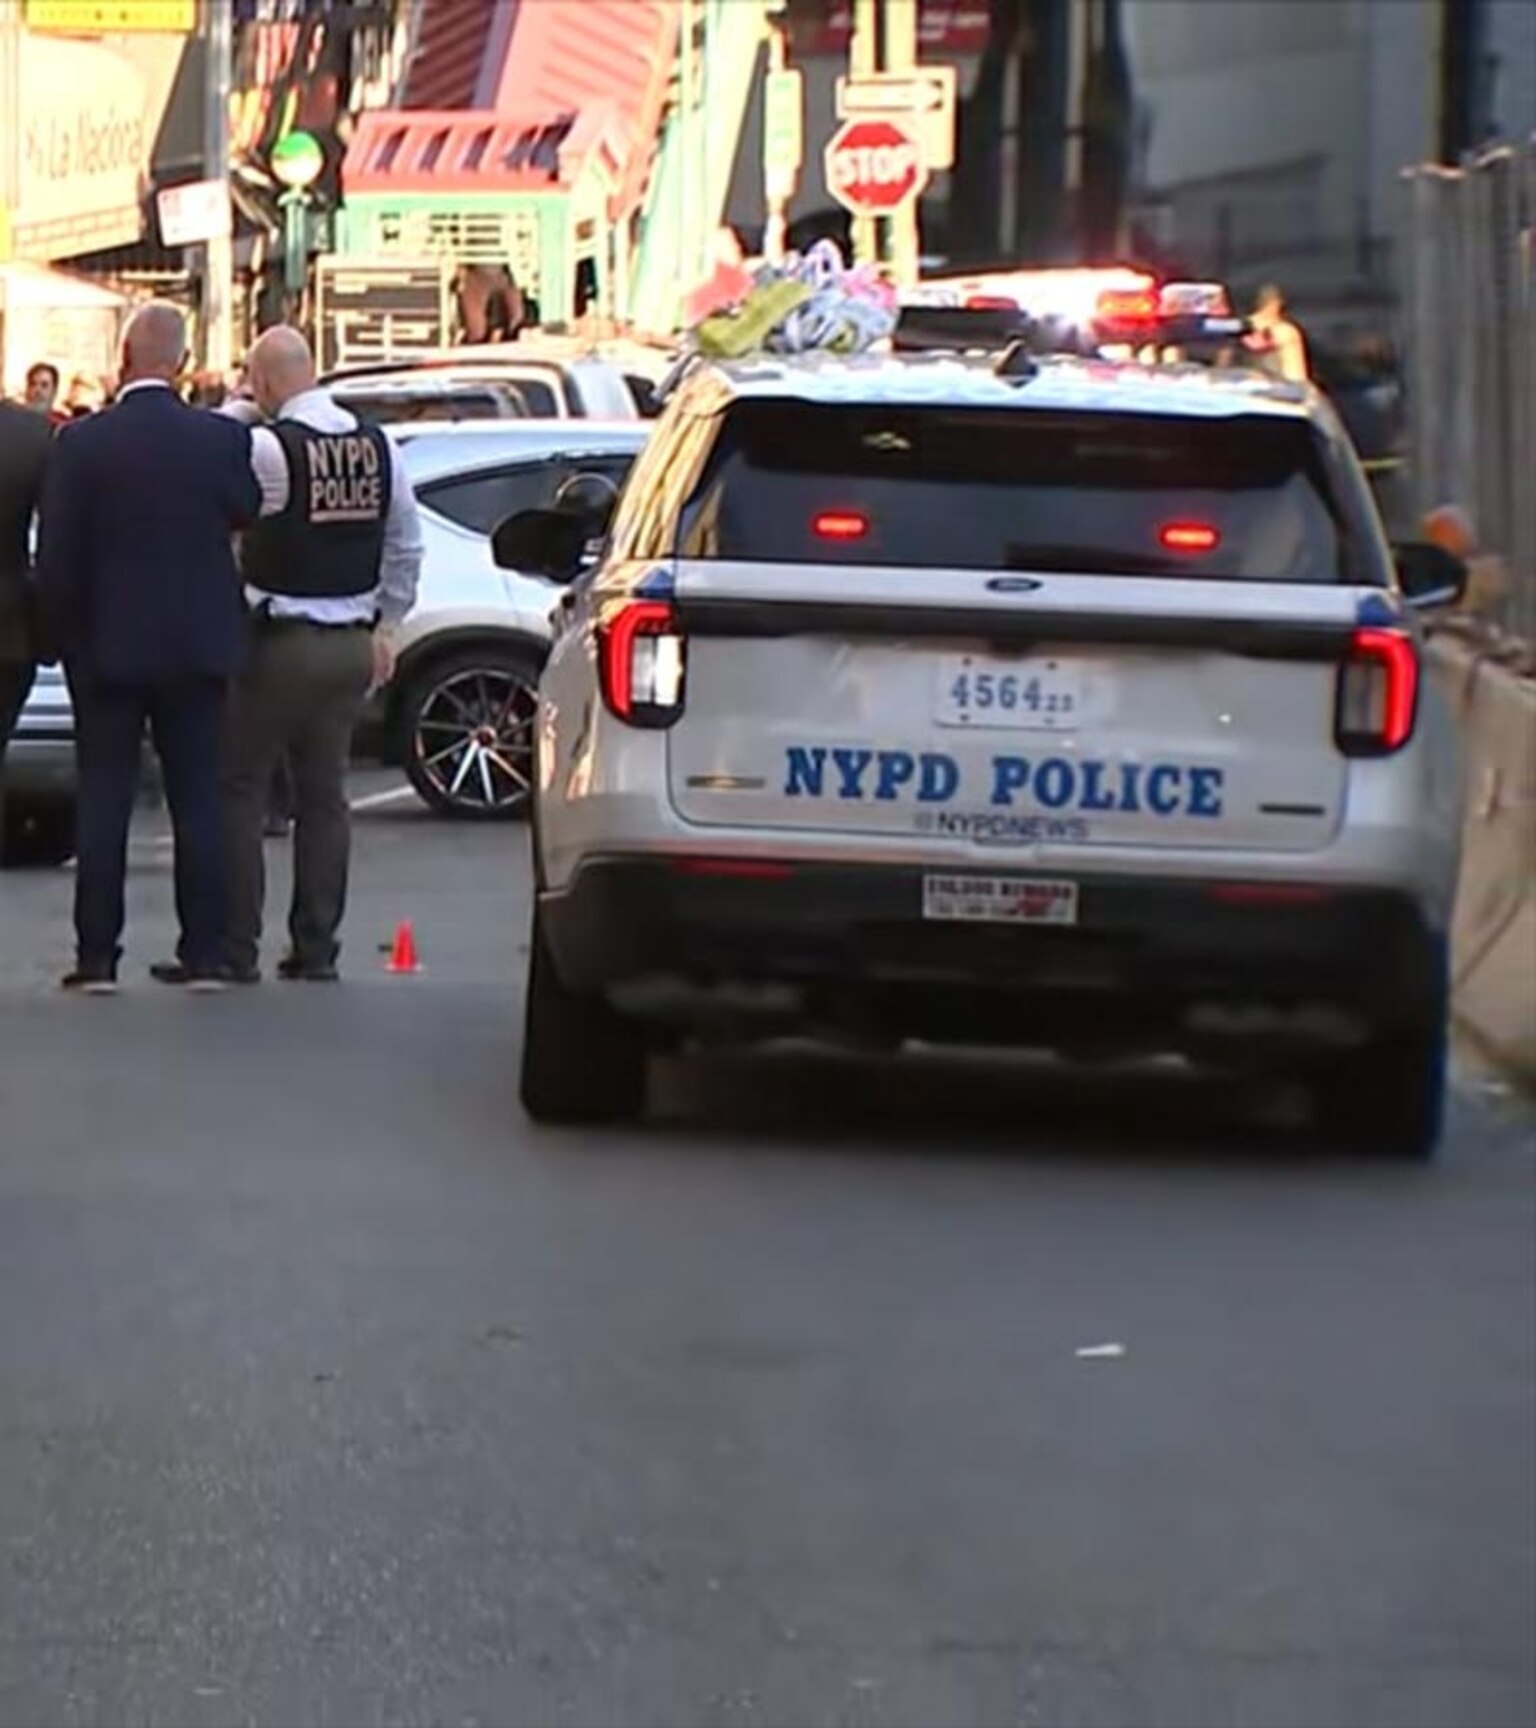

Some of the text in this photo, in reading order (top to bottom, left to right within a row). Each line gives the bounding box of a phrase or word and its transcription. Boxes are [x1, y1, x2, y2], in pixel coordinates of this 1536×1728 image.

[834, 141, 917, 186] STOP
[306, 436, 380, 478] NYPD
[310, 476, 381, 510] POLICE
[950, 674, 1041, 711] 4564
[784, 747, 1226, 817] NYPD POLICE
